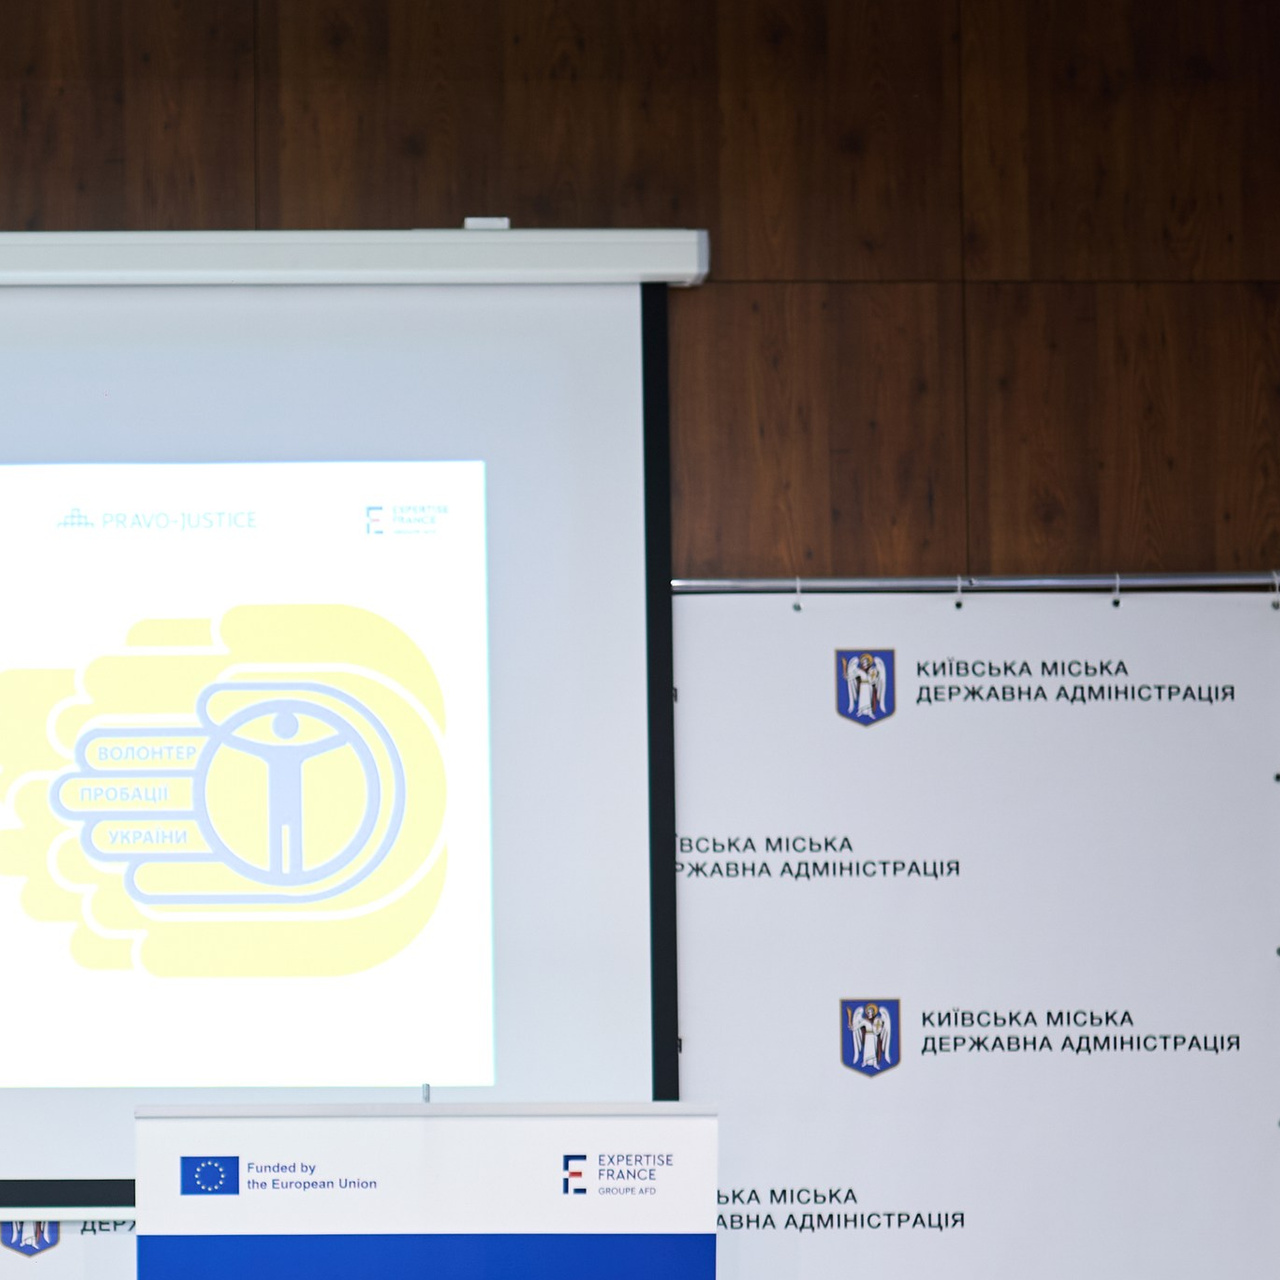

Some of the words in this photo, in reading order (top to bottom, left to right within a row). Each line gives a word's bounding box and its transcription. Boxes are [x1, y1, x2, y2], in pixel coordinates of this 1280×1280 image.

[102, 509, 257, 530] PRAVO-JUSTICE
[916, 659, 1033, 678] КИЇВСЬКА
[1040, 659, 1129, 678] МІСЬКА
[915, 685, 1048, 705] ДЕРЖАВНА
[1055, 684, 1235, 705] АДМІНІСТРАЦІЯ
[97, 745, 197, 762] ВОЛОНТЕР
[79, 783, 169, 803] ПРОБАЦІЇ
[108, 827, 188, 845] УКРАЇНИ
[765, 836, 853, 853] МІСЬКА
[779, 859, 960, 881] АДМІНІСТРАЦІЯ
[921, 1008, 1038, 1028] КИЇВСЬКА
[1046, 1010, 1134, 1028] МІСЬКА
[920, 1035, 1053, 1056] ДЕРЖАВНА
[1060, 1034, 1241, 1055] АДМІНІСТРАЦІЯ
[247, 1162, 296, 1173] Funded
[300, 1162, 316, 1175] by
[598, 1154, 673, 1166] EXPERTISE
[598, 1168, 656, 1181] FRANCE
[247, 1179, 267, 1190] the
[272, 1178, 334, 1191] European
[339, 1178, 377, 1189] Union
[598, 1187, 636, 1195] GROUPE
[638, 1187, 657, 1195] AFD
[769, 1188, 858, 1205] МІСЬКА
[784, 1212, 965, 1233] АДМІНІСТРАЦІЯ
